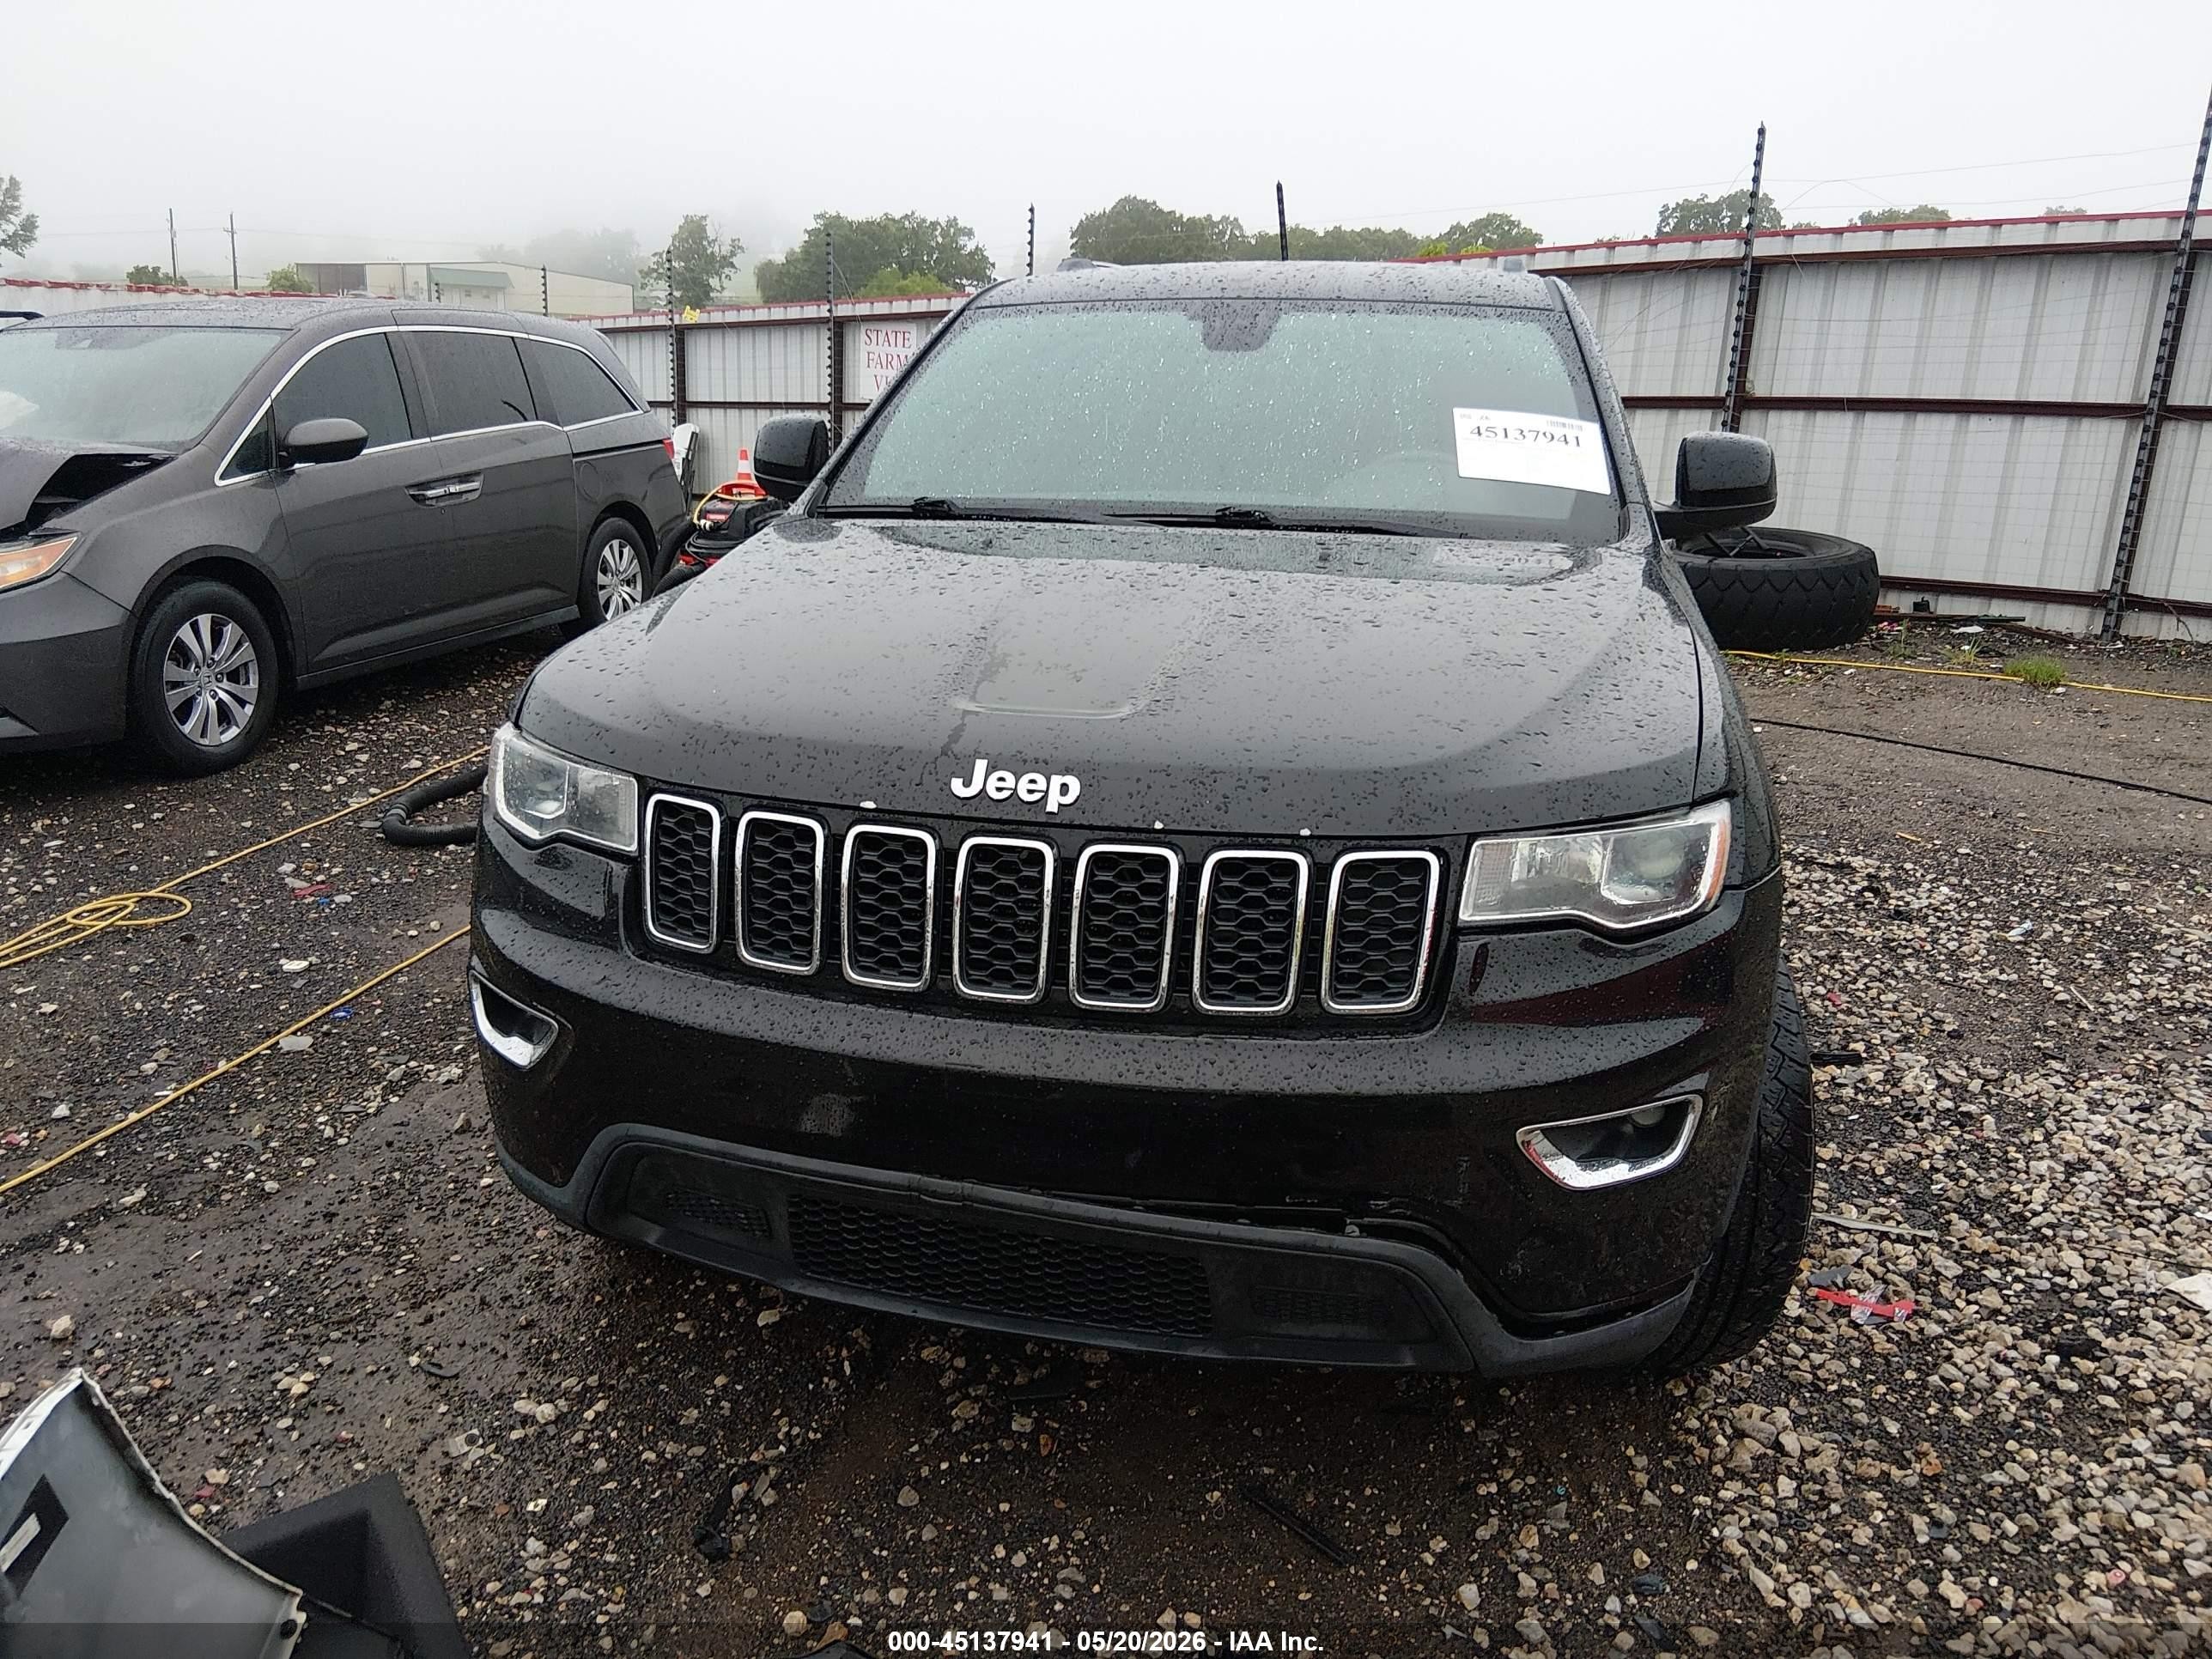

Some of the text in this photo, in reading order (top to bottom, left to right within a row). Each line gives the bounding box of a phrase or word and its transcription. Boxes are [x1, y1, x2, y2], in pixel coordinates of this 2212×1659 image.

[865, 328, 911, 349] STATE
[1469, 425, 1582, 447] 45137941
[950, 758, 1081, 815] Jeep
